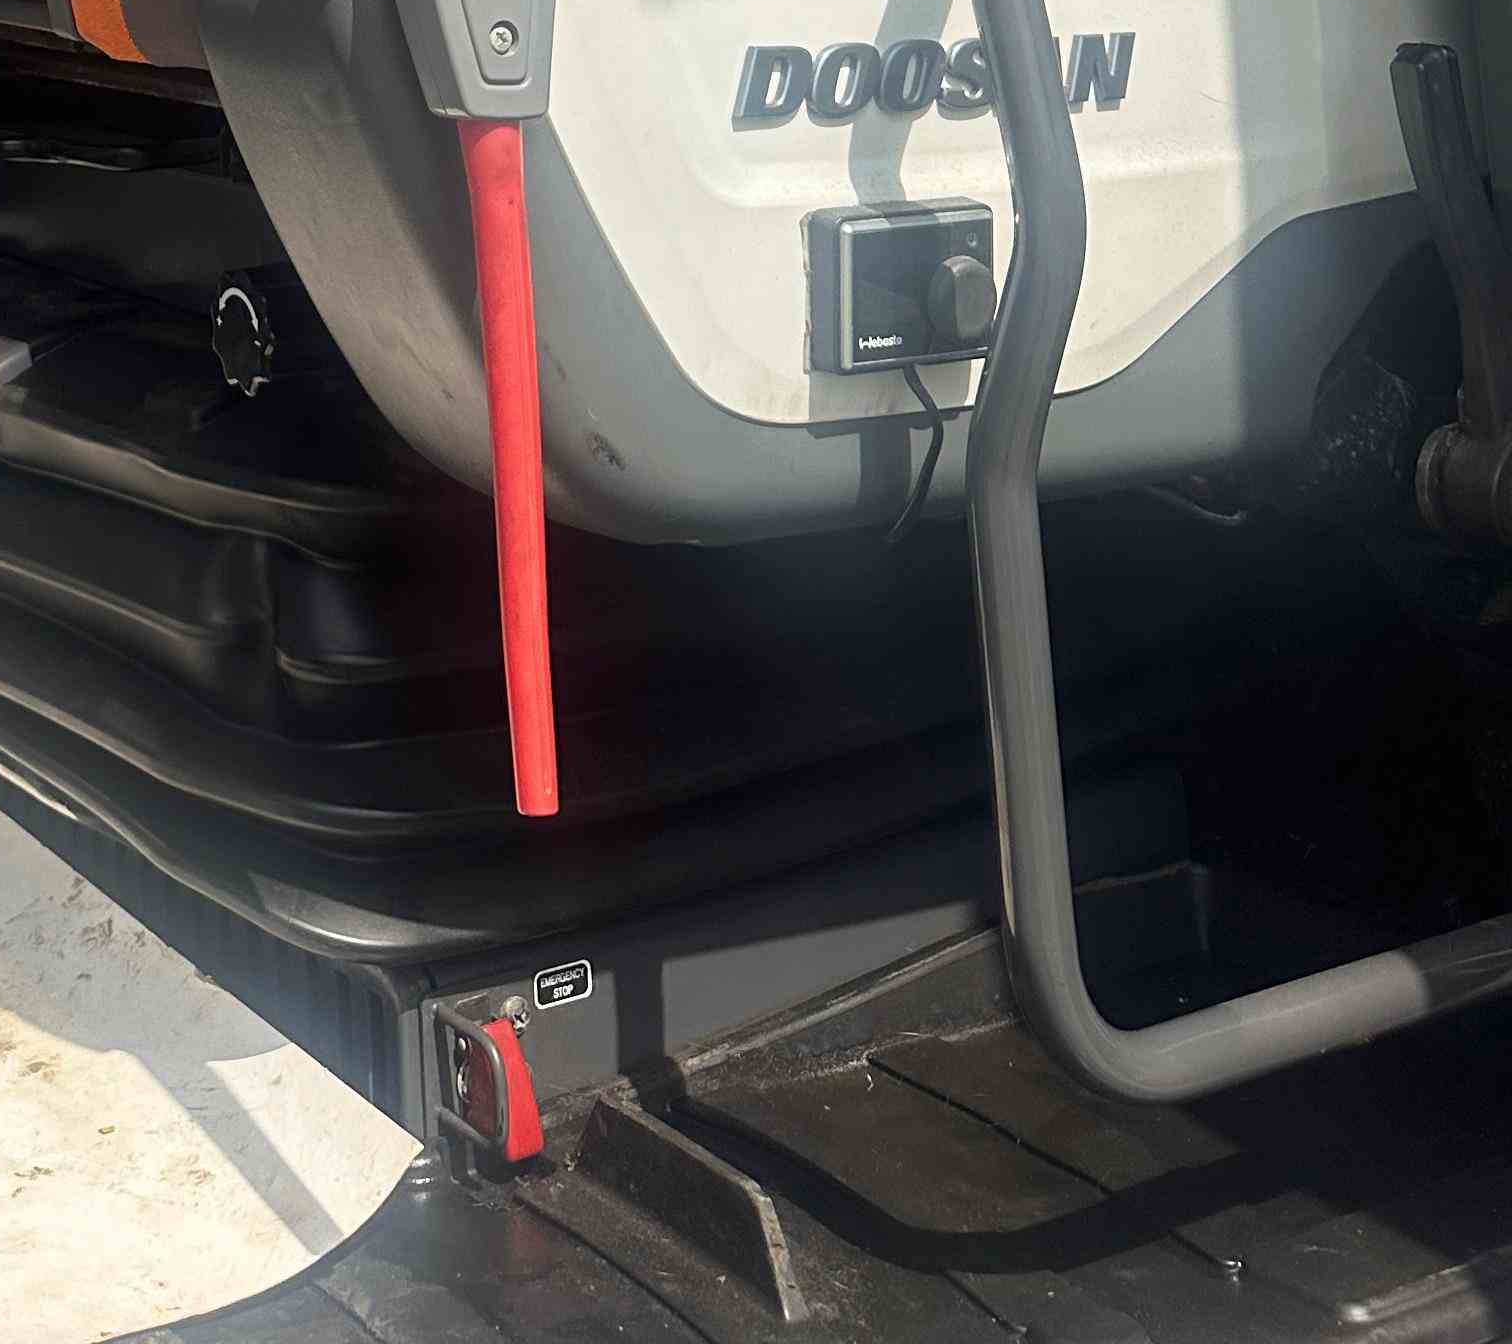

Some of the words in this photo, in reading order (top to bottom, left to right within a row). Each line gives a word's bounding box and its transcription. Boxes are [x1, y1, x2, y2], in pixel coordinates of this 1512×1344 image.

[731, 30, 1137, 126] DOOSN
[539, 967, 586, 989] EMERGENCY
[552, 984, 574, 1000] STOP
